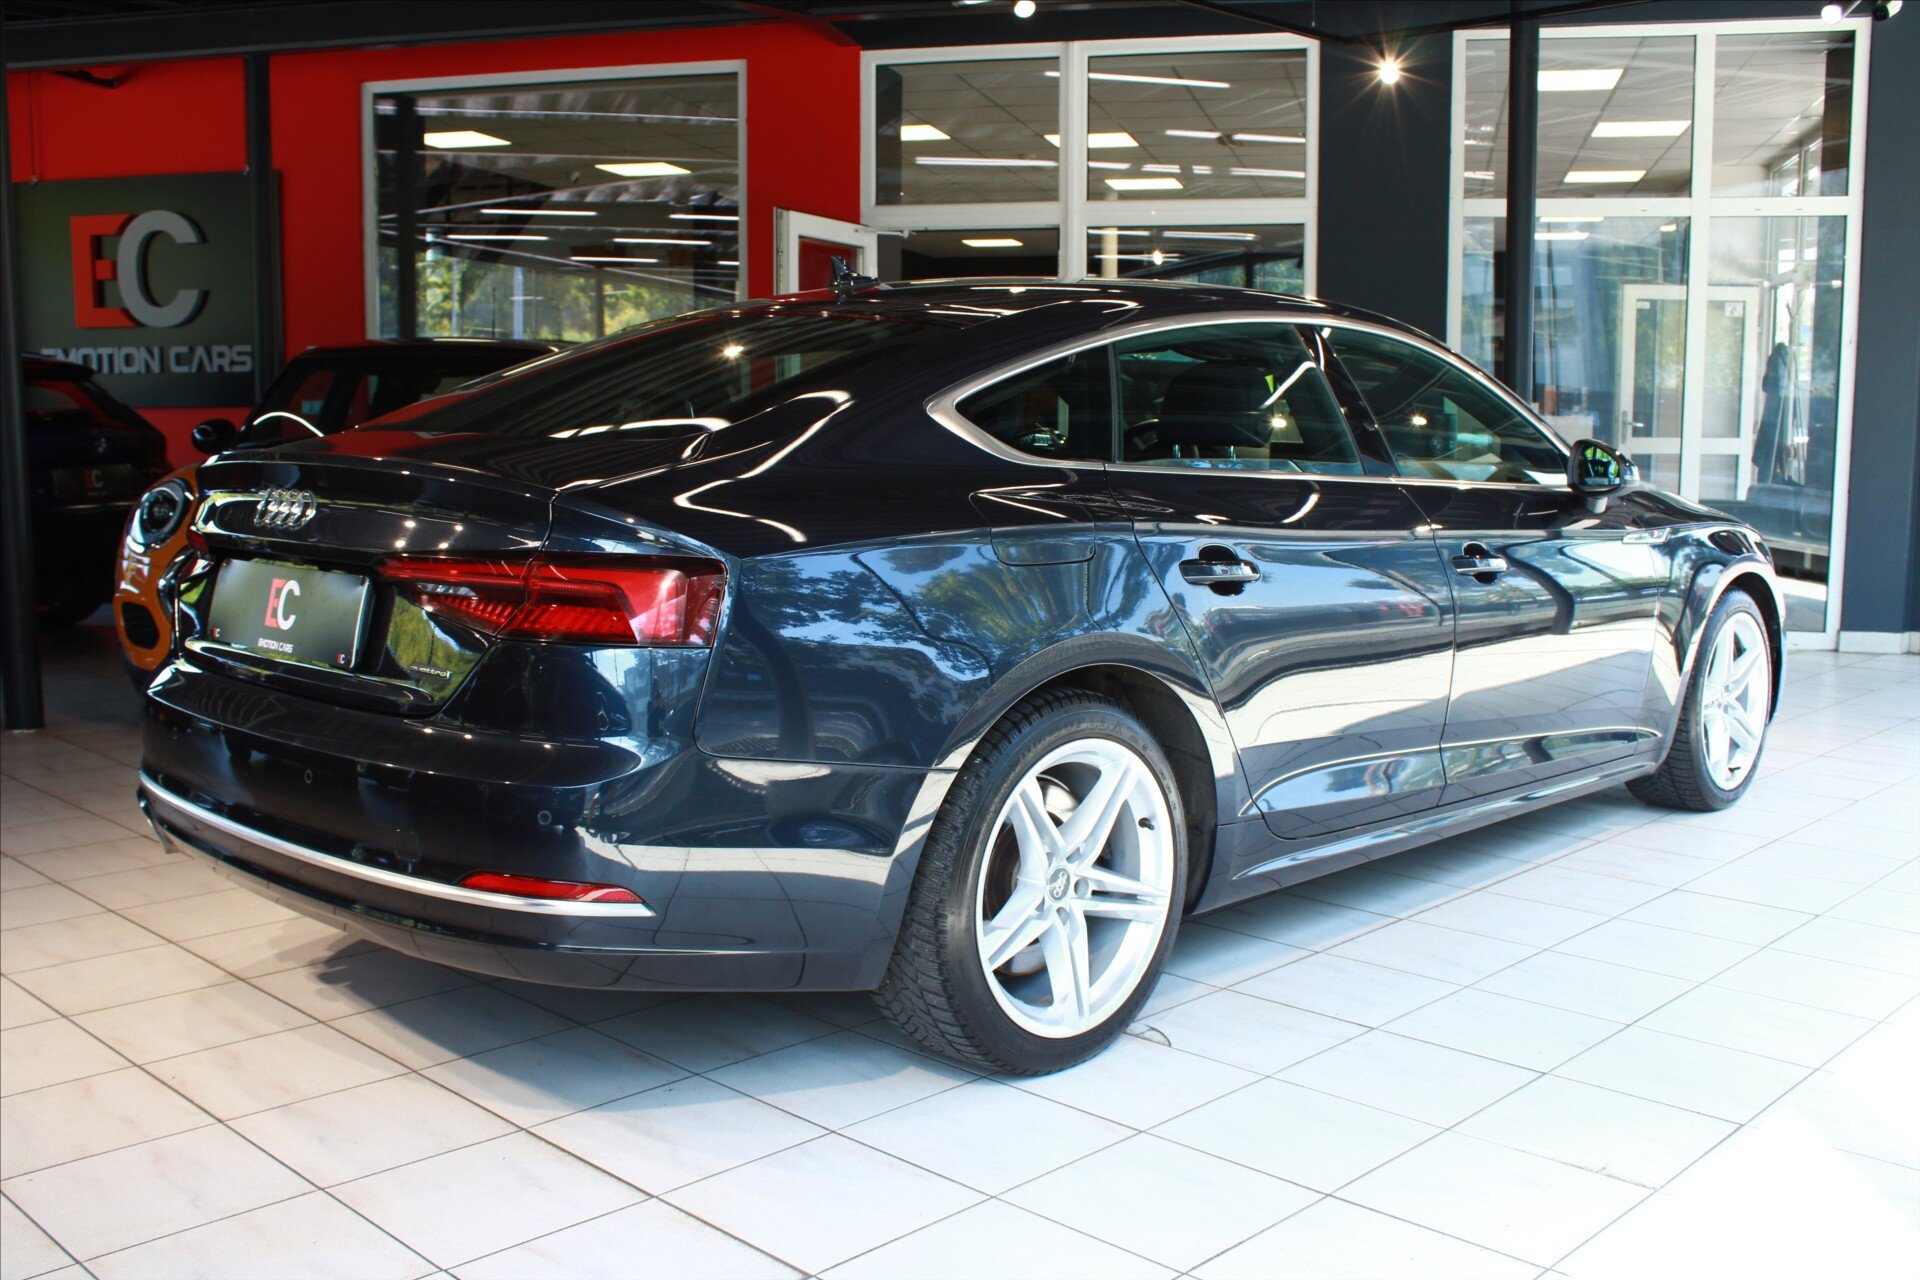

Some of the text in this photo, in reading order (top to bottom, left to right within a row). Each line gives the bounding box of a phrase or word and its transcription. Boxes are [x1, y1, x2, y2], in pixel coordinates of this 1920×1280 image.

[70, 209, 202, 329] EC
[169, 345, 254, 374] CARS
[264, 577, 300, 631] EC
